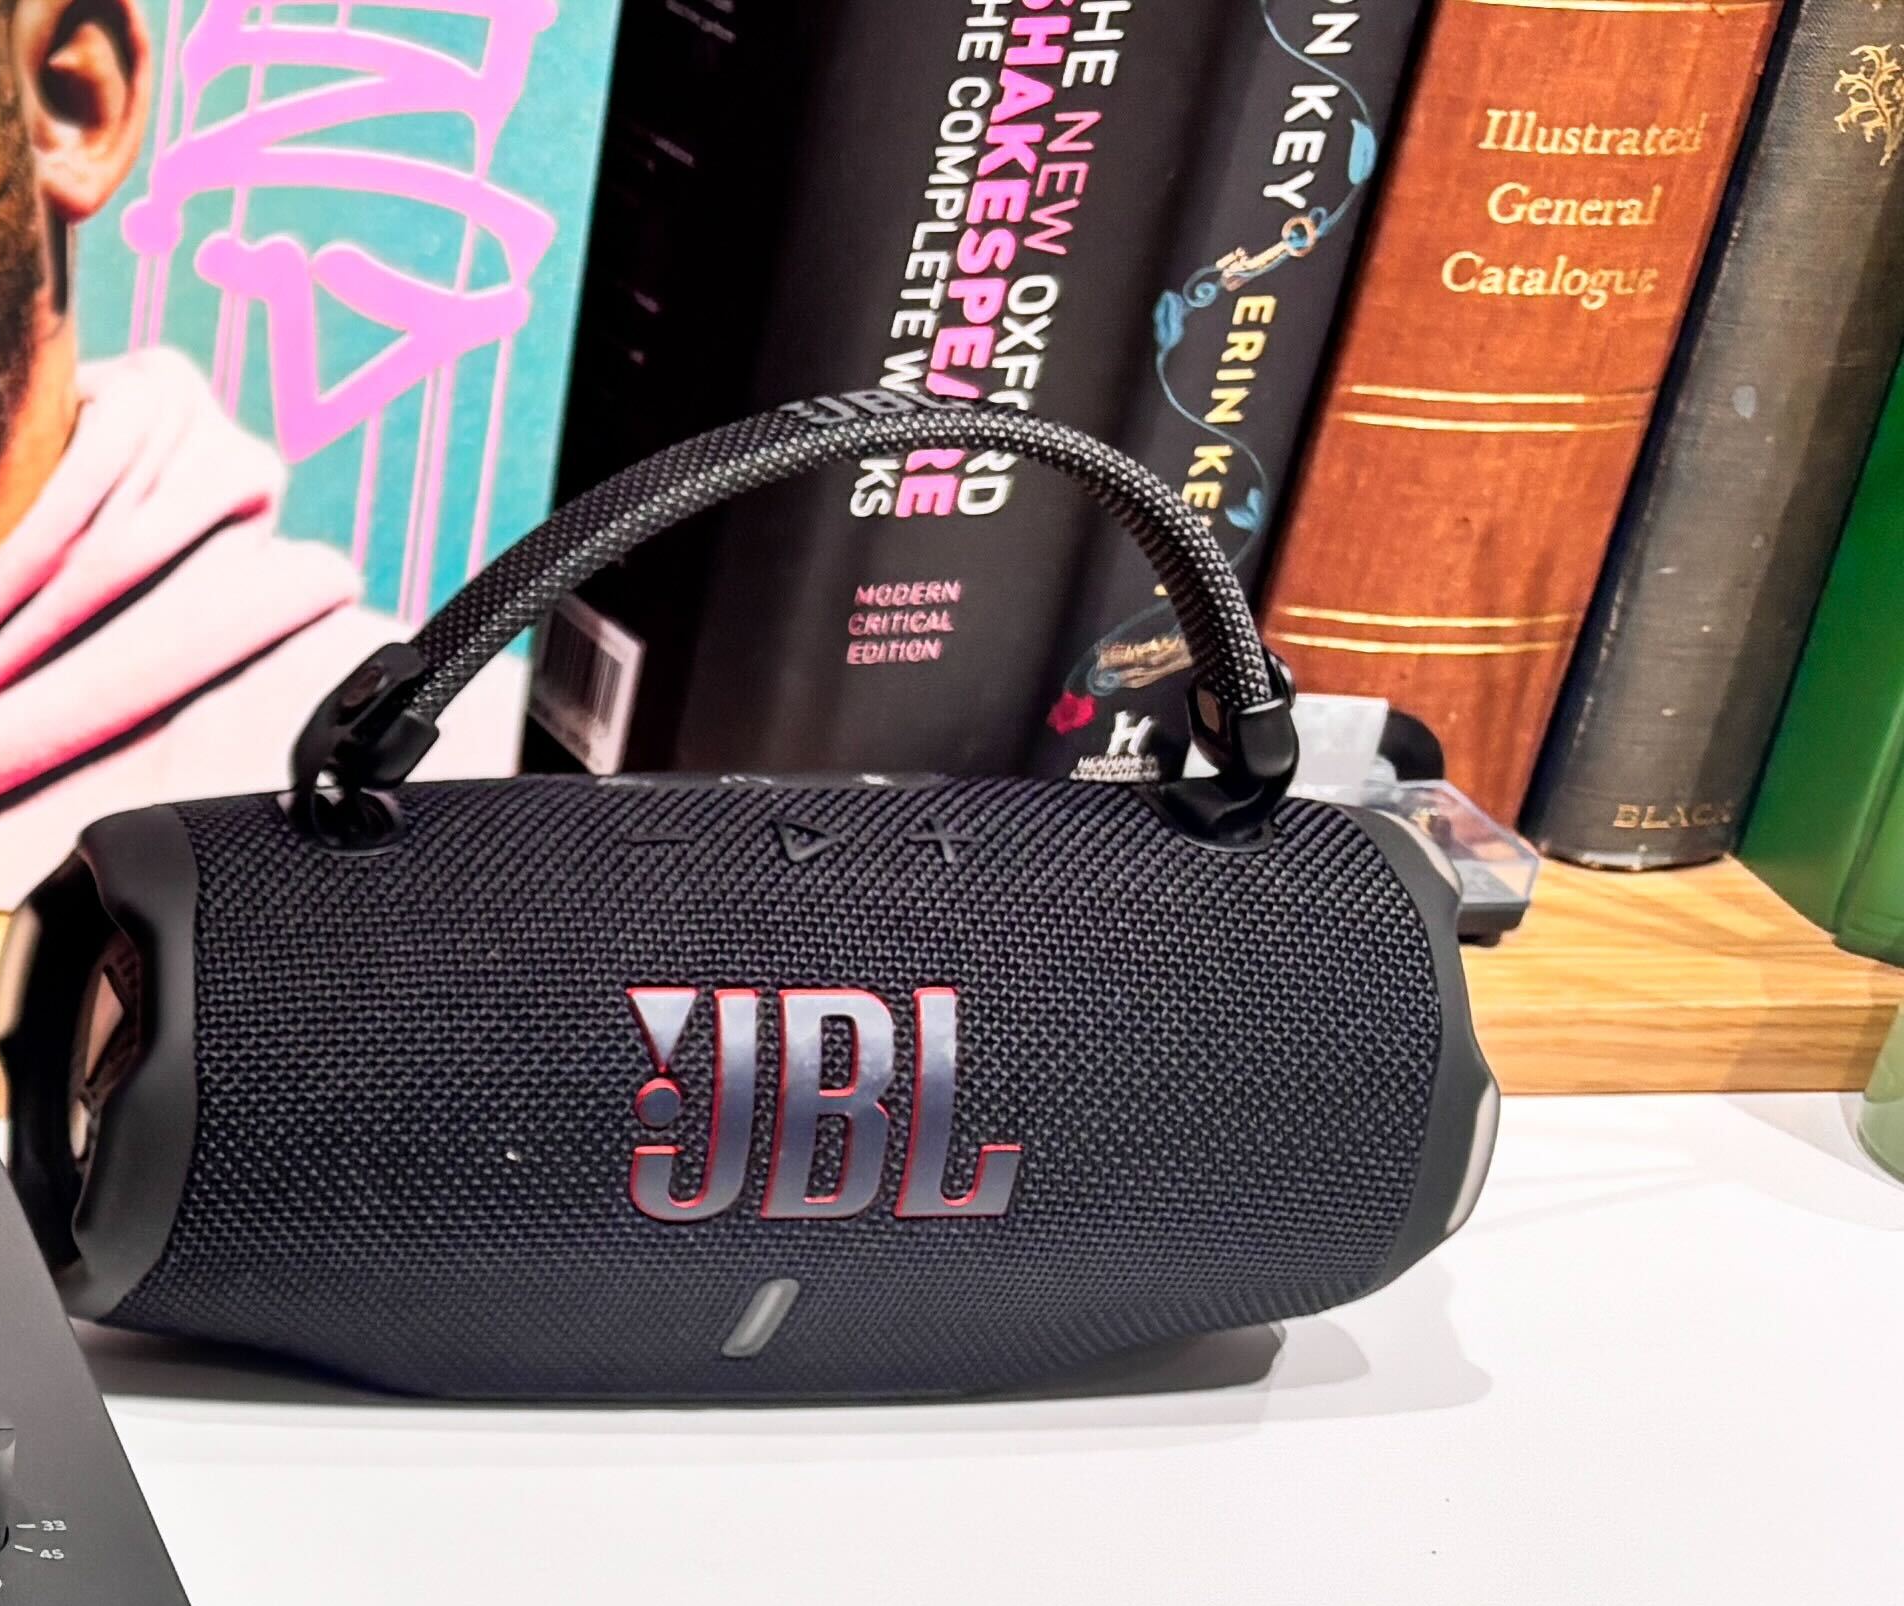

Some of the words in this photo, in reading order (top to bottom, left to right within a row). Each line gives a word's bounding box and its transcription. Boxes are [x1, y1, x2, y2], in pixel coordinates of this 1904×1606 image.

[1262, 84, 1340, 209] KEY
[1478, 108, 1709, 157] Illustrated
[890, 76, 993, 342] COMPLETE
[1020, 111, 1102, 256] NEW
[1488, 182, 1663, 226] General
[894, 0, 1076, 518] HAKESPERE
[1442, 250, 1659, 311] Catalogue
[958, 274, 1061, 516] OXFRD
[1204, 295, 1277, 424] ERIN
[850, 350, 928, 518] WKS
[848, 610, 954, 636] CRITICAL
[854, 579, 962, 607] MODERN
[847, 638, 944, 665] EDITION
[626, 986, 1023, 1222] JBL
[39, 1548, 66, 1560] 45
[40, 1520, 68, 1532] 33
